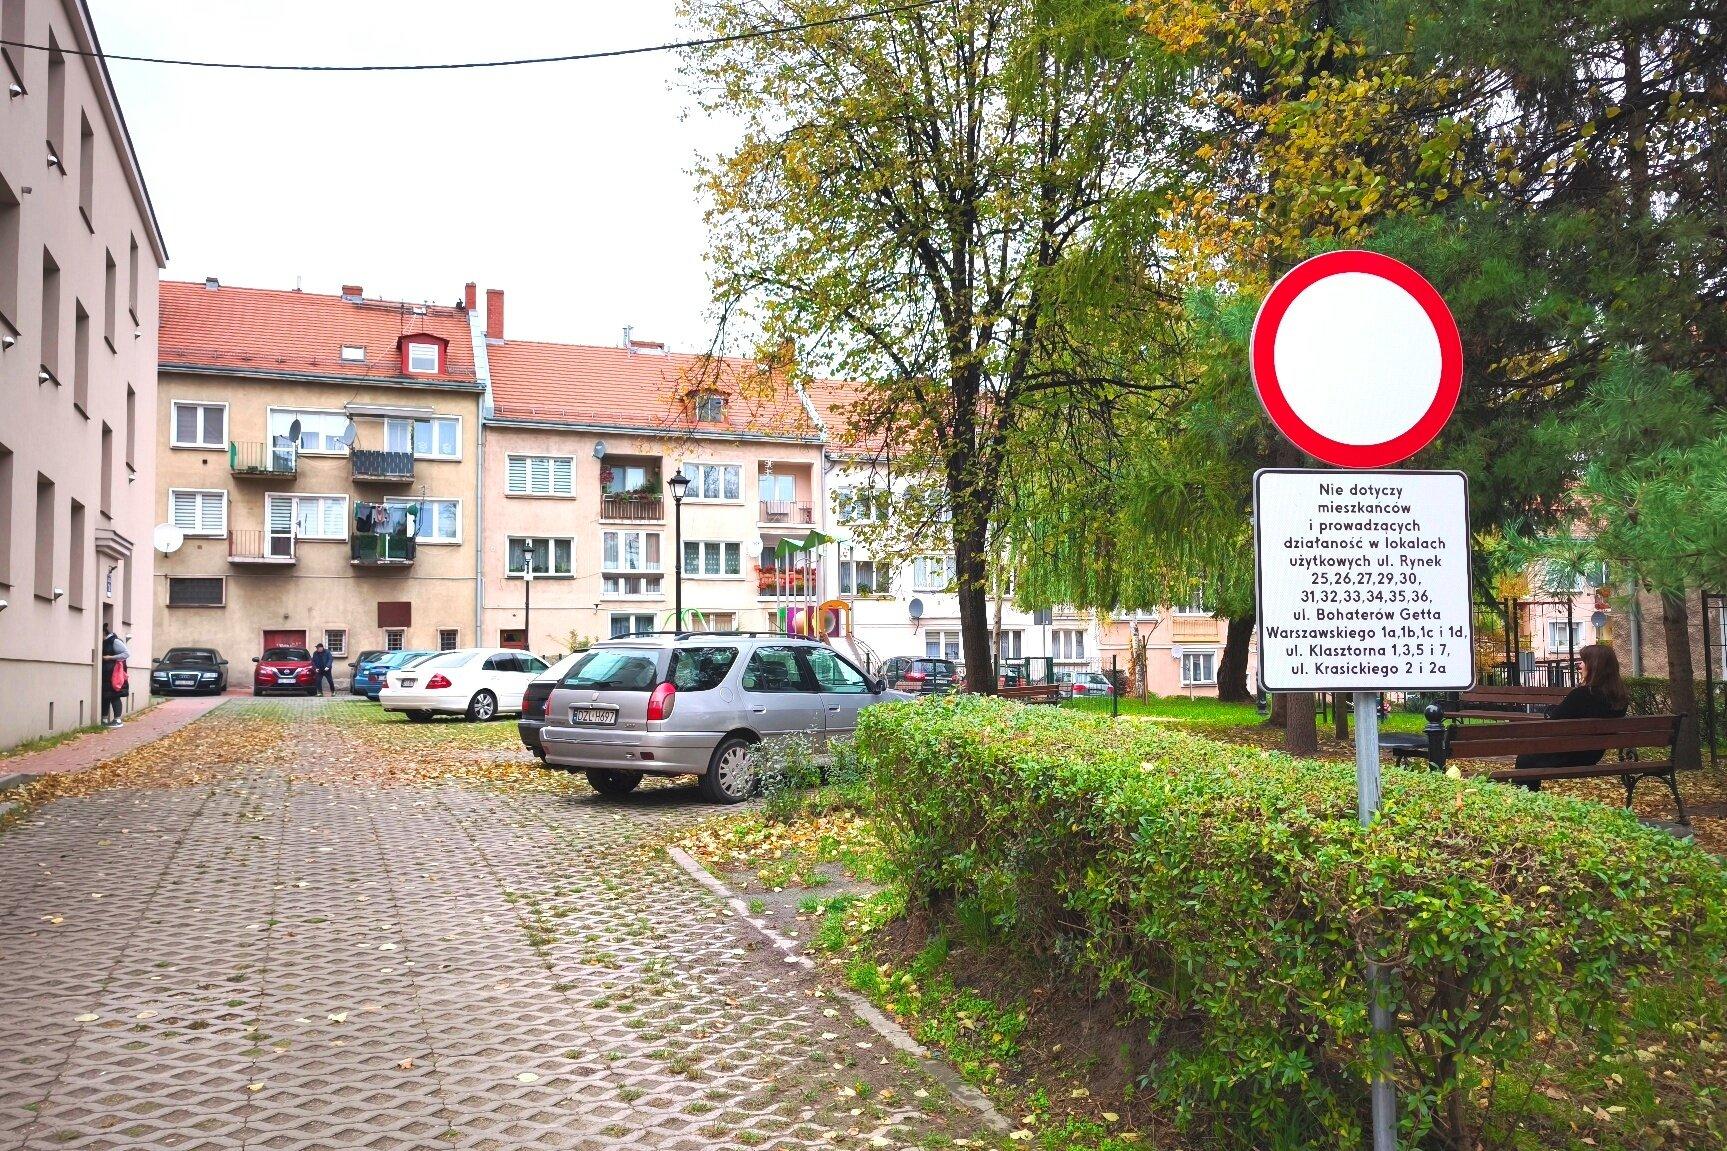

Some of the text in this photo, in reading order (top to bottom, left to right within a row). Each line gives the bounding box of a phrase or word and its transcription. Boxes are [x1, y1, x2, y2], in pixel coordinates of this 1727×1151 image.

[1320, 484, 1402, 499] Nie dotyczy
[1318, 500, 1410, 513] mieszkańców
[1309, 519, 1420, 534] i prowadzących
[1284, 537, 1362, 548] działaność
[1386, 537, 1445, 549] lokalach
[1290, 555, 1441, 570] użytkowych ul. Rynek
[1312, 572, 1421, 586] 25,26,27,29,30,
[1301, 590, 1432, 604] 31,32,33,34,35,36,
[1294, 608, 1440, 620] ul. Bohaterów Getta
[1266, 626, 1467, 641] Warszawskiego 1a,1b,1c i 1d,
[1286, 644, 1450, 657] ul. Klasztorna 1,3,5 i 7,
[1292, 662, 1446, 677] ul. Krasickiego 2 i 2a
[577, 710, 615, 724] DZL H697
